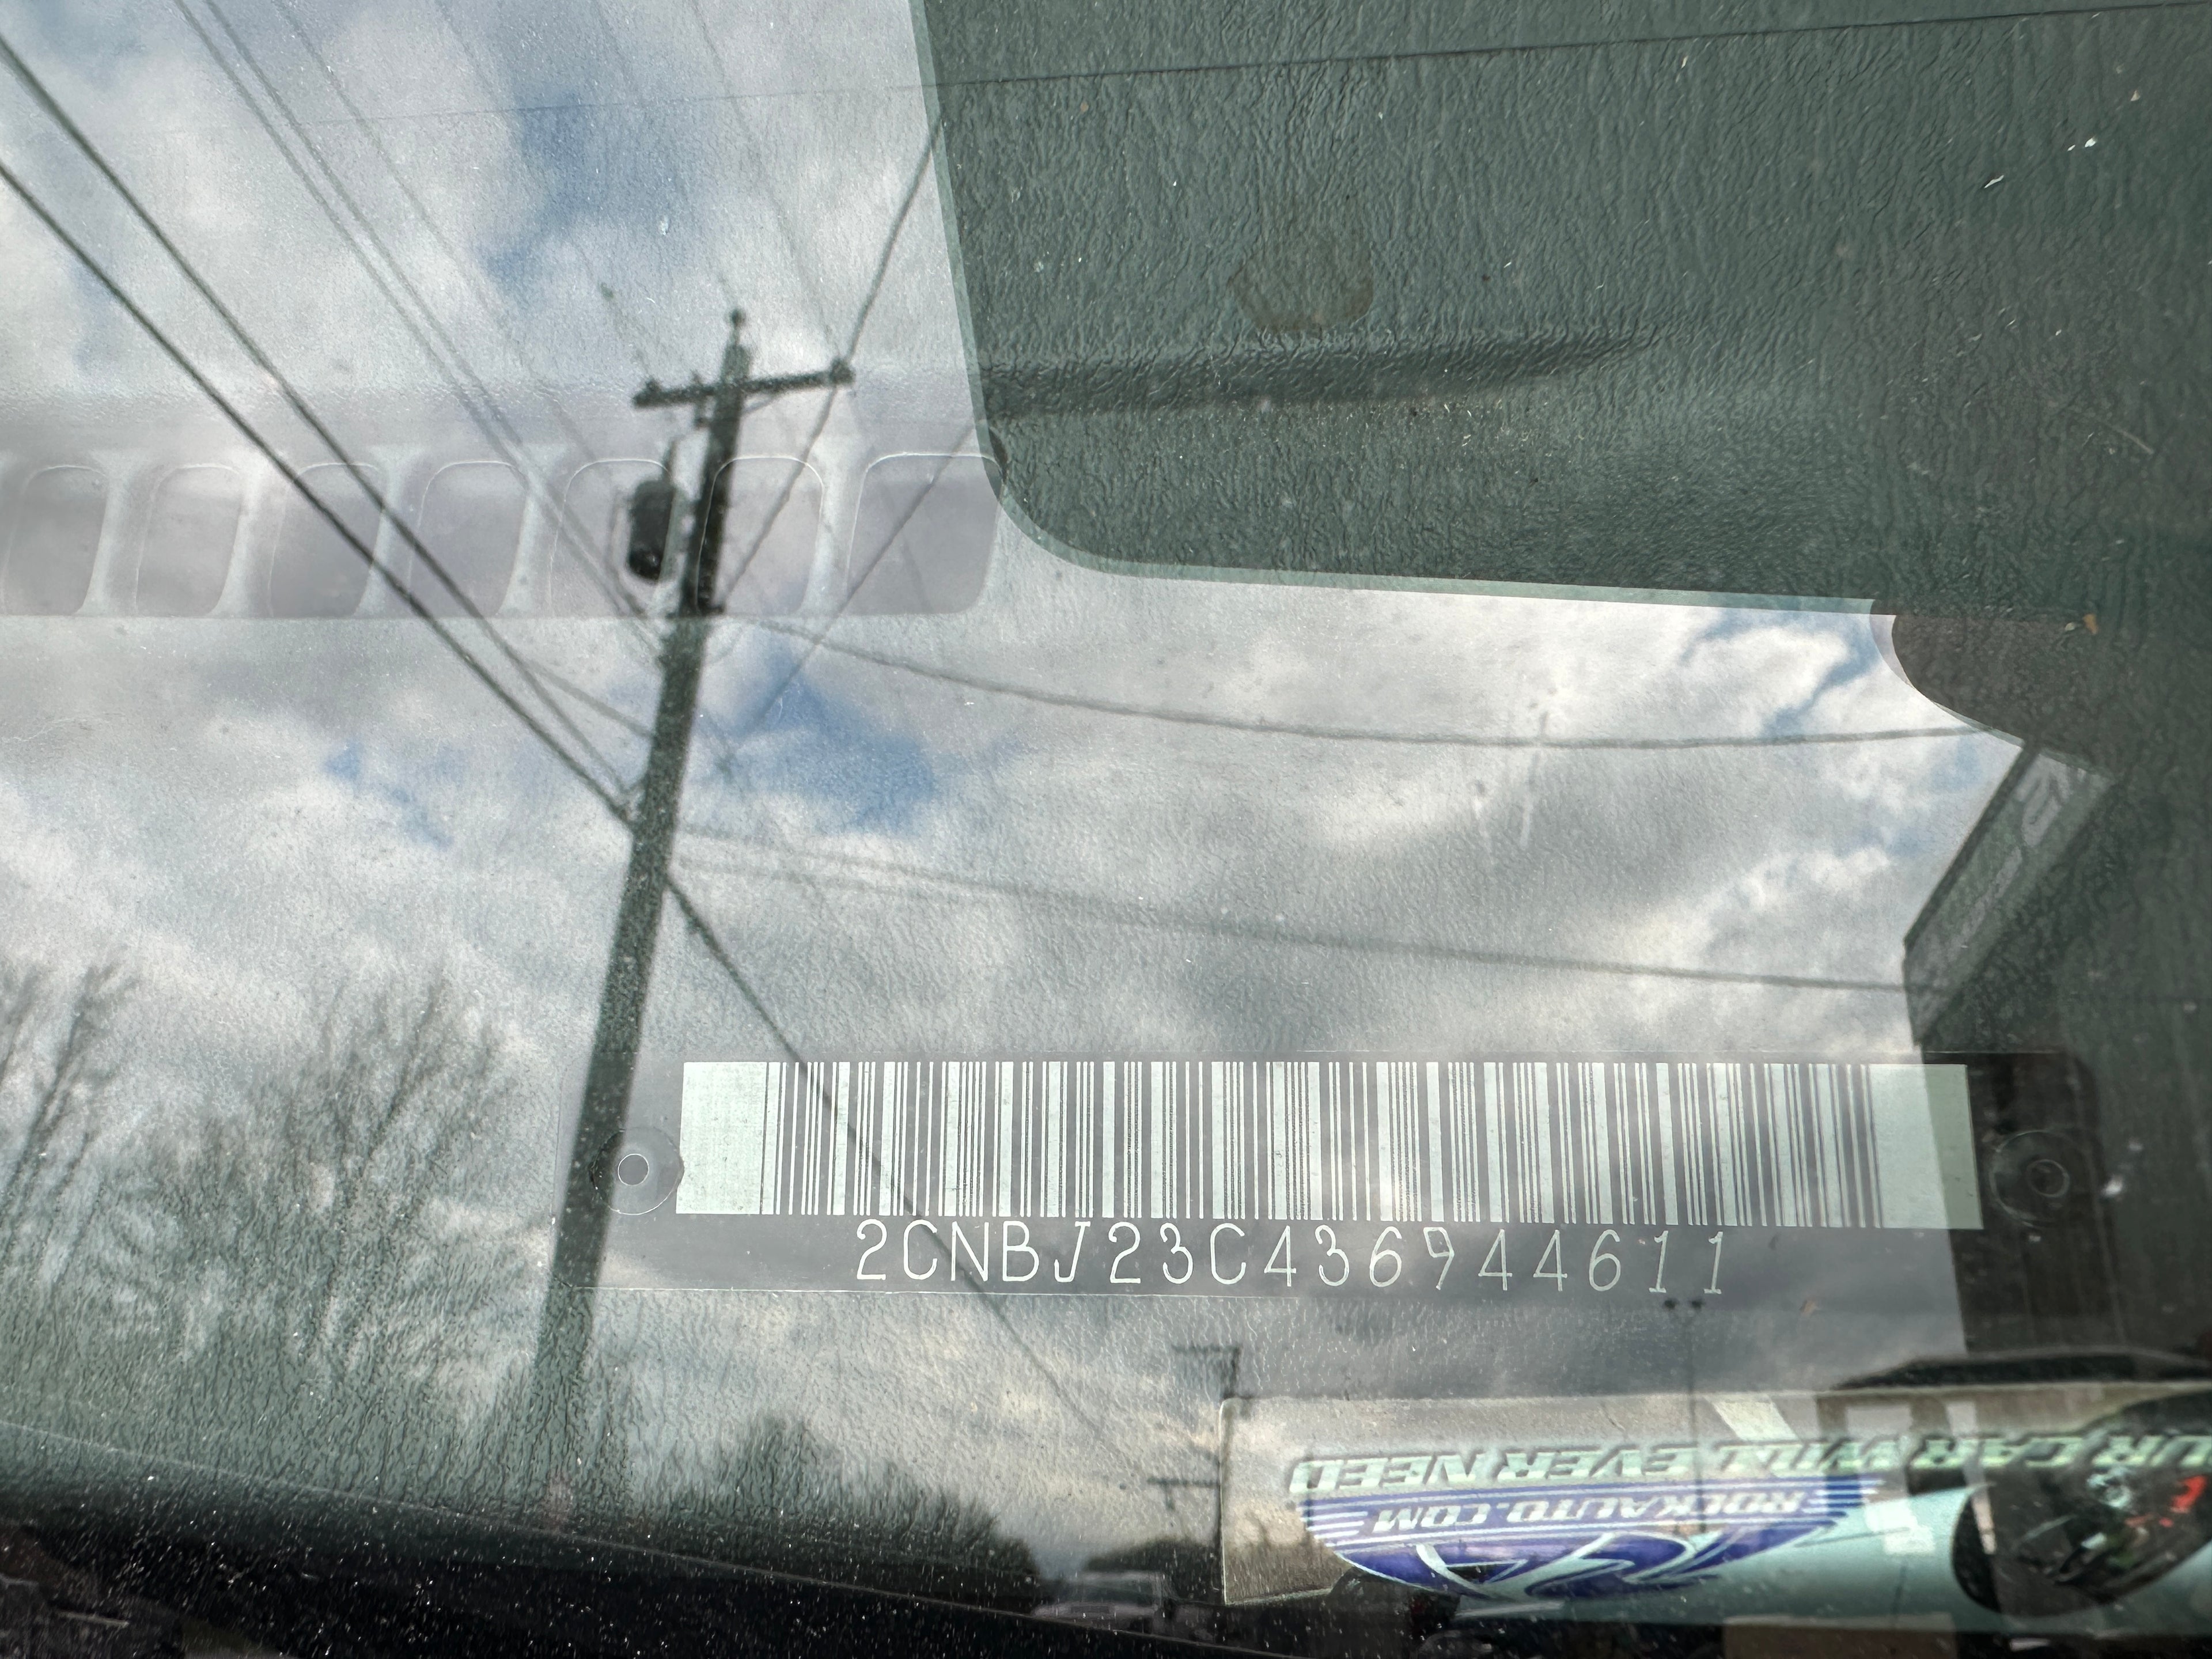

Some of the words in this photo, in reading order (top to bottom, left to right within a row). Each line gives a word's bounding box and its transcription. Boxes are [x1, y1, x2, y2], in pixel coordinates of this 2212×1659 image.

[855, 1217, 1724, 1294] 2CNBJ23C436944611
[1498, 1447, 1703, 1480] EVER
[1715, 1441, 1906, 1474] WILL
[1910, 1437, 2082, 1468] CAR
[2092, 1435, 2212, 1467] UR
[1289, 1453, 1482, 1494] NEED
[1374, 1492, 1805, 1532] ROCKAUTO.COM
